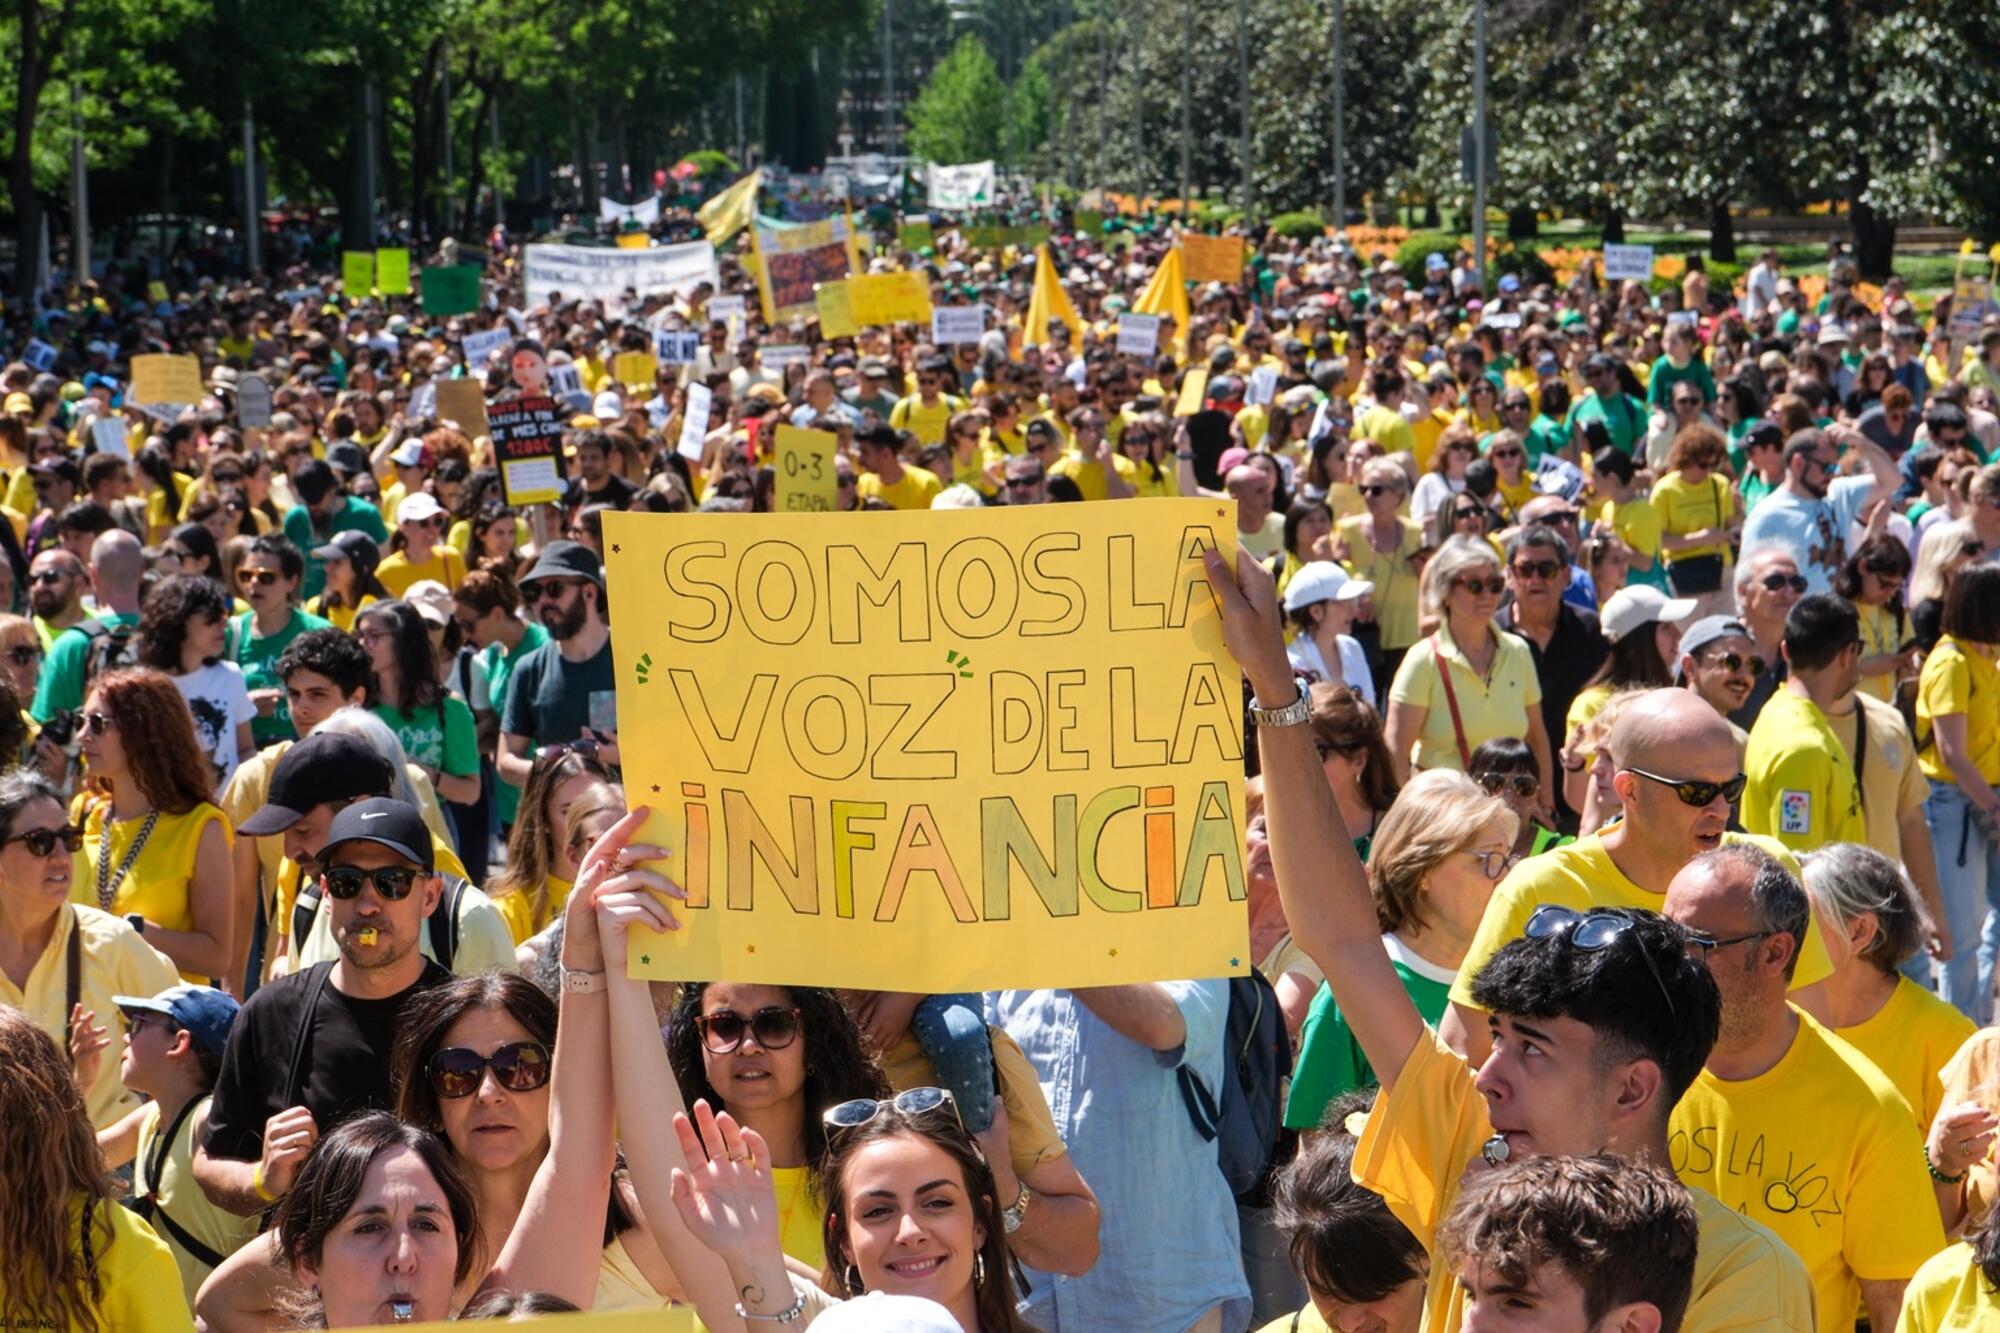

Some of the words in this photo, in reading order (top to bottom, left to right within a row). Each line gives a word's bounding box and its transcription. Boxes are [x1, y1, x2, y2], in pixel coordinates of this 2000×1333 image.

[512, 423, 539, 438] MES
[663, 531, 1087, 645] SOMOS
[1107, 525, 1224, 632] LA
[668, 668, 958, 781] VOZ
[990, 668, 1090, 775] DE
[1110, 662, 1245, 769] LA
[1786, 821, 1802, 830] LFP
[1727, 1129, 1765, 1178] LA
